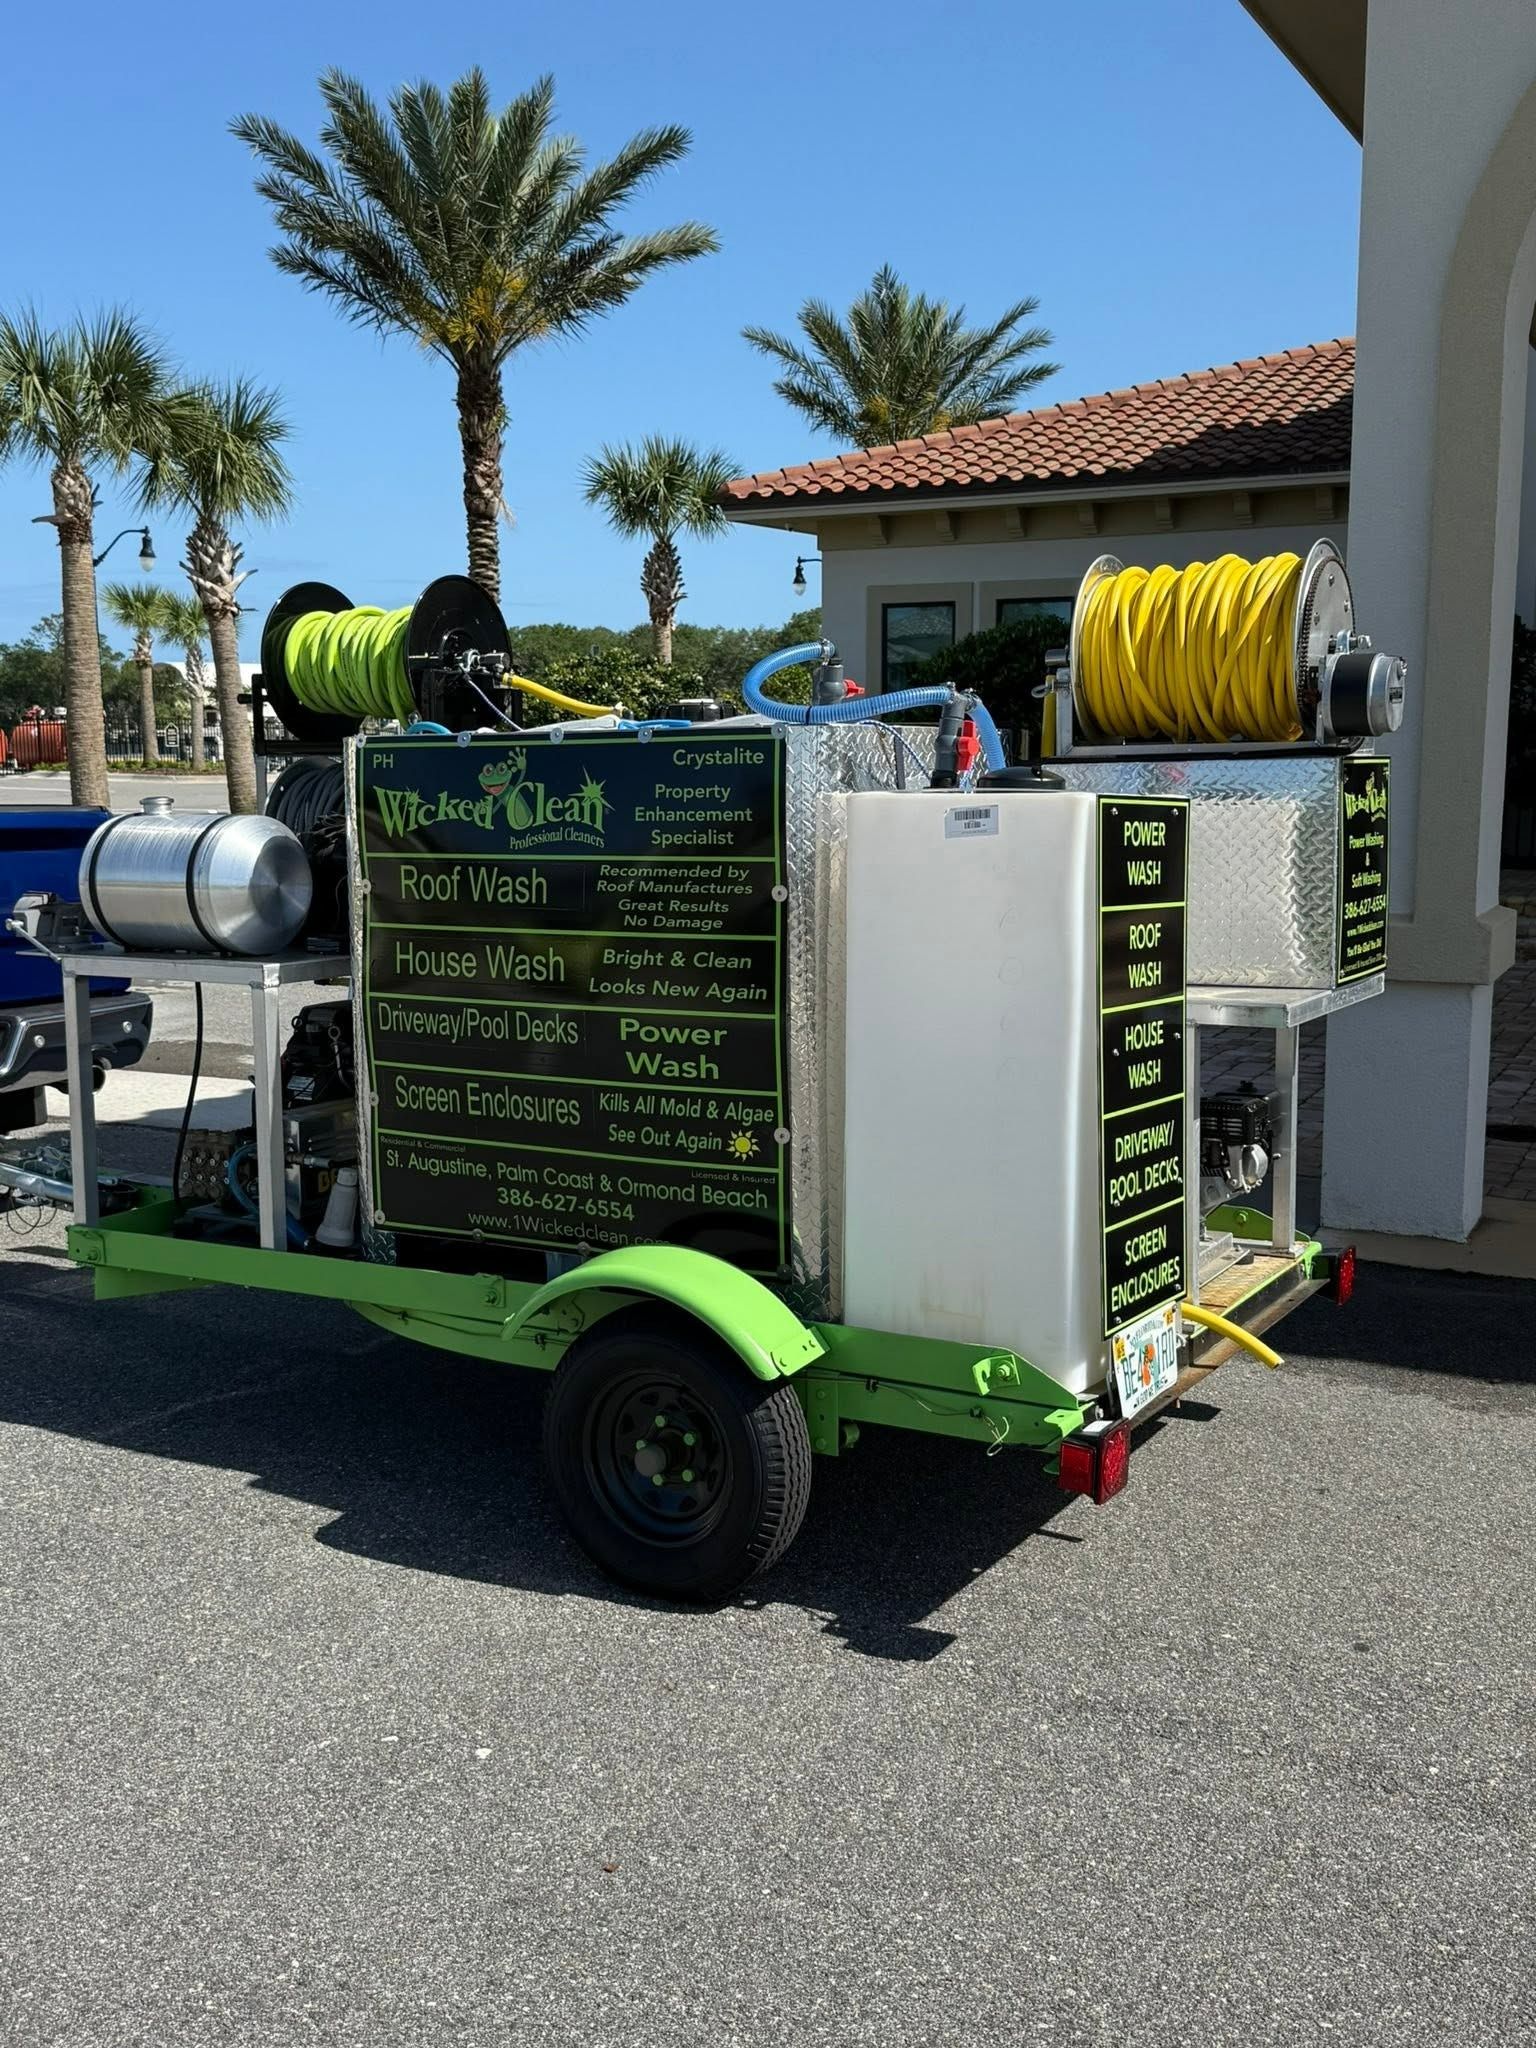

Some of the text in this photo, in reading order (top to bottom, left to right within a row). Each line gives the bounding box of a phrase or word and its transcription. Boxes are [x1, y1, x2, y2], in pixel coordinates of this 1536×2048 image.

[373, 754, 394, 768] PH
[673, 748, 764, 769] Crystalite
[655, 784, 731, 802] Property
[373, 781, 606, 838] Wicked Clean
[635, 807, 753, 822] Enhancement
[510, 828, 605, 850] Professional Cleaners
[652, 830, 734, 847] Specialist
[1124, 821, 1165, 847] POWER
[1349, 832, 1384, 849] Power Washing
[401, 865, 547, 904] Roof Wash
[600, 865, 750, 881] Recommended by
[1127, 861, 1161, 885] WASH
[1362, 870, 1381, 887] Washing
[597, 880, 753, 895] Roof Manufactures
[618, 899, 729, 913] Great Results
[1344, 894, 1386, 919] 386-627-6554
[623, 915, 723, 931] No Damage
[1130, 924, 1161, 950] ROOF
[396, 941, 564, 981] House Wash
[603, 948, 752, 969] Bright & Clean
[1128, 961, 1161, 988] WASH
[589, 978, 767, 1003] Looks New Again
[379, 1003, 579, 1045] Driveway/Pool Decks
[620, 1018, 727, 1046] Power
[1125, 1020, 1164, 1051] HOUSE
[626, 1051, 719, 1080] Wash
[1128, 1059, 1161, 1089] WASH
[396, 1076, 580, 1126] Screen Enclosures
[600, 1092, 774, 1126] Kills All Mold & Algae
[380, 1136, 415, 1147] Residential
[424, 1142, 466, 1153] Commercial
[608, 1124, 722, 1154] See Out Again
[1115, 1120, 1174, 1163] DRIVEWAY/
[387, 1150, 767, 1208] St. Augustine, Palm Coast & Ormond Beach
[691, 1170, 729, 1180] Licensed
[742, 1175, 775, 1184] Insured
[1111, 1156, 1178, 1204] POOL DECKS
[498, 1187, 634, 1222] 386-627-6554
[468, 1213, 670, 1245] www.1Wickedcleanco
[1125, 1224, 1166, 1266] SCREEN
[1111, 1256, 1180, 1312] ENCLOSURES
